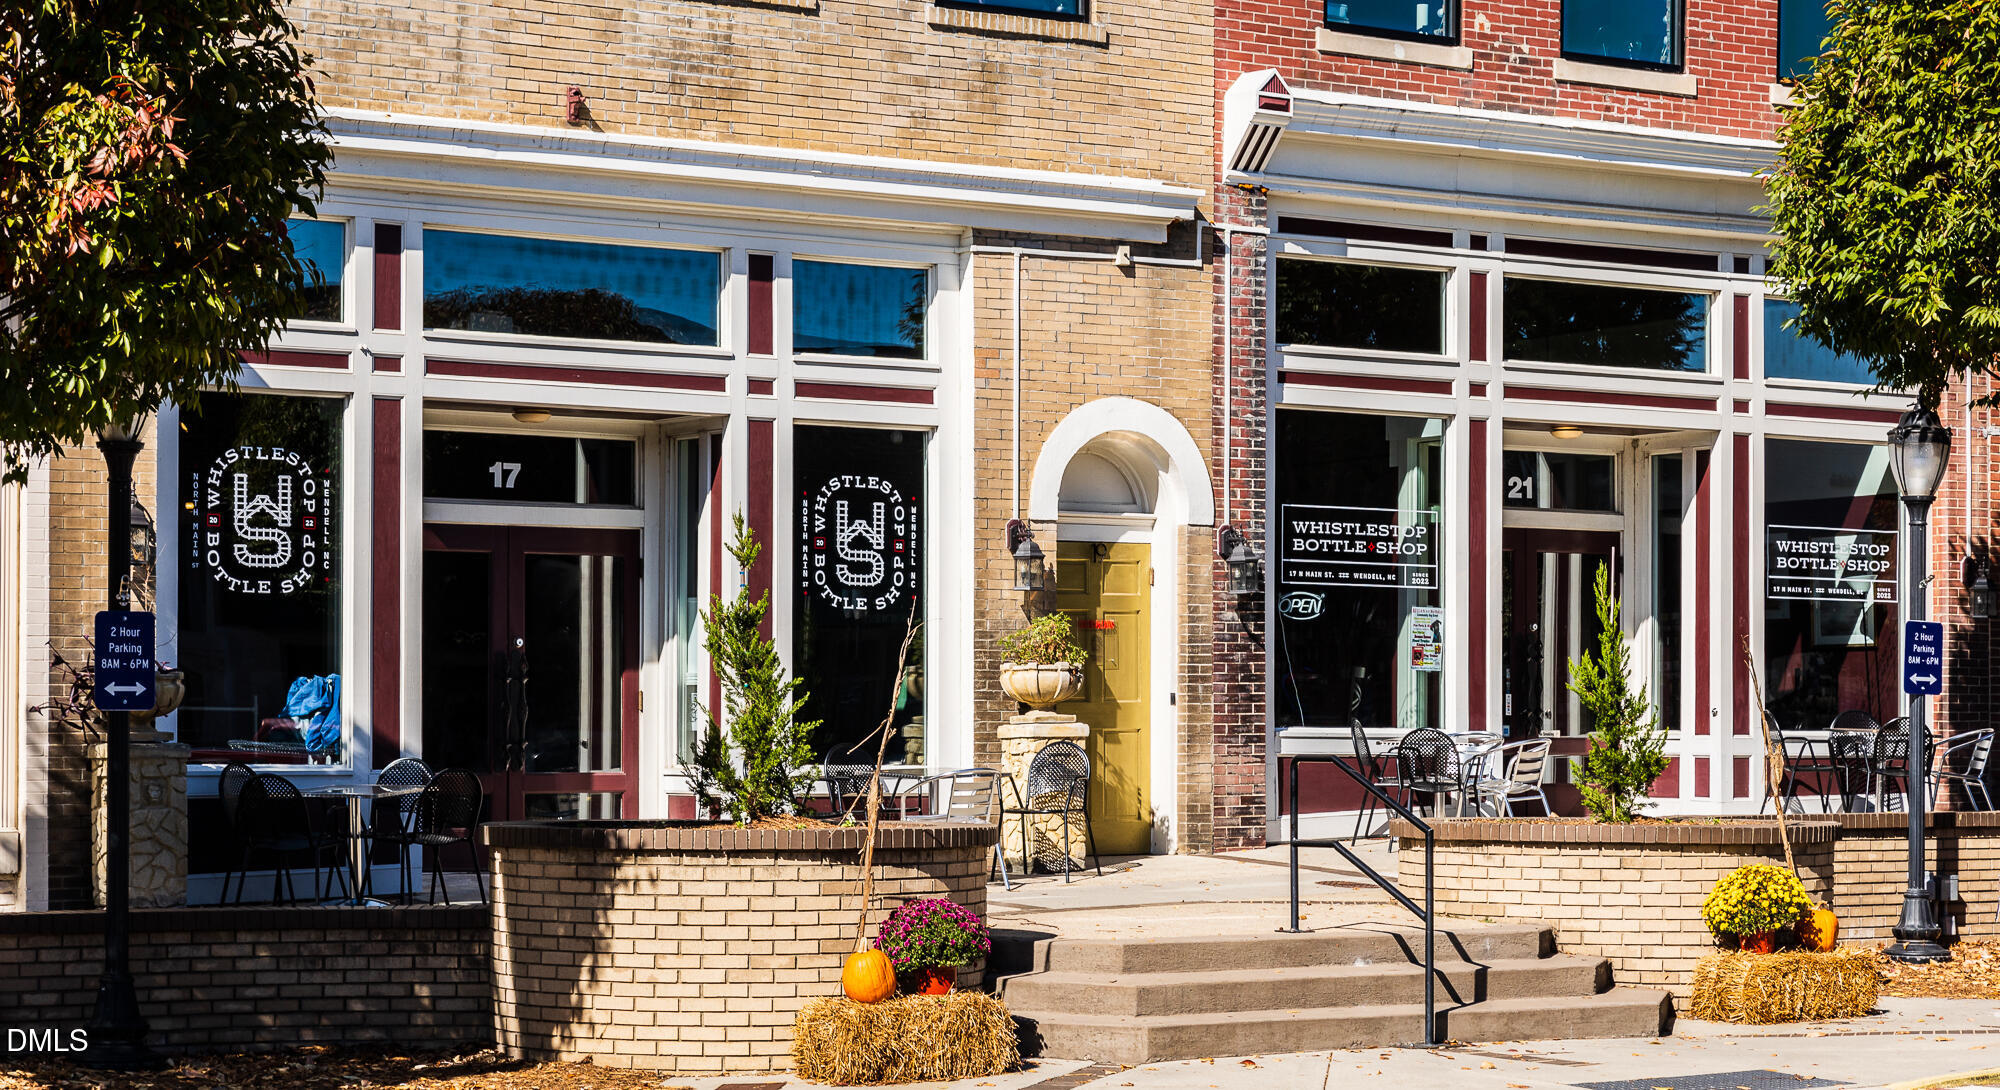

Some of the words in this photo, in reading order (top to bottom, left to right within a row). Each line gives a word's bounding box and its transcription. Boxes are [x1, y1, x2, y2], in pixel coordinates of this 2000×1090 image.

[207, 446, 316, 512] WHISTLESTOP
[489, 461, 521, 488] 17
[1508, 476, 1533, 499] 21
[814, 475, 905, 537] WHISTLESTOP
[209, 516, 218, 524] 20
[305, 519, 314, 527] 22
[1292, 520, 1427, 538] WHISTLESTOP
[895, 542, 903, 550] 22
[1292, 538, 1367, 553] BOTTLE
[1376, 541, 1428, 556] SHOP
[1776, 540, 1890, 556] WHISTLESTOP
[207, 532, 271, 594] BOTTLE
[281, 534, 316, 594] SHOP
[323, 551, 330, 569] NC
[1776, 556, 1839, 570] BOTTLE
[1847, 559, 1891, 573] SHOP
[814, 553, 867, 611] BOTTLE
[875, 556, 905, 611] SHOP
[910, 571, 917, 588] NC
[1305, 570, 1323, 578] MAIN
[1353, 572, 1386, 581] WENDELL,
[1411, 577, 1430, 585] 2022
[1279, 598, 1323, 613] OPEN
[110, 626, 117, 637] 2
[120, 626, 140, 637] Hour
[1914, 632, 1919, 641] 2
[1920, 632, 1934, 642] Hour
[108, 642, 142, 656] Parking
[1913, 644, 1935, 656] Parking
[101, 658, 120, 669] 8AM
[130, 658, 149, 669] 6PM
[1908, 655, 1921, 664] 8AM
[1926, 656, 1939, 665] 6PM
